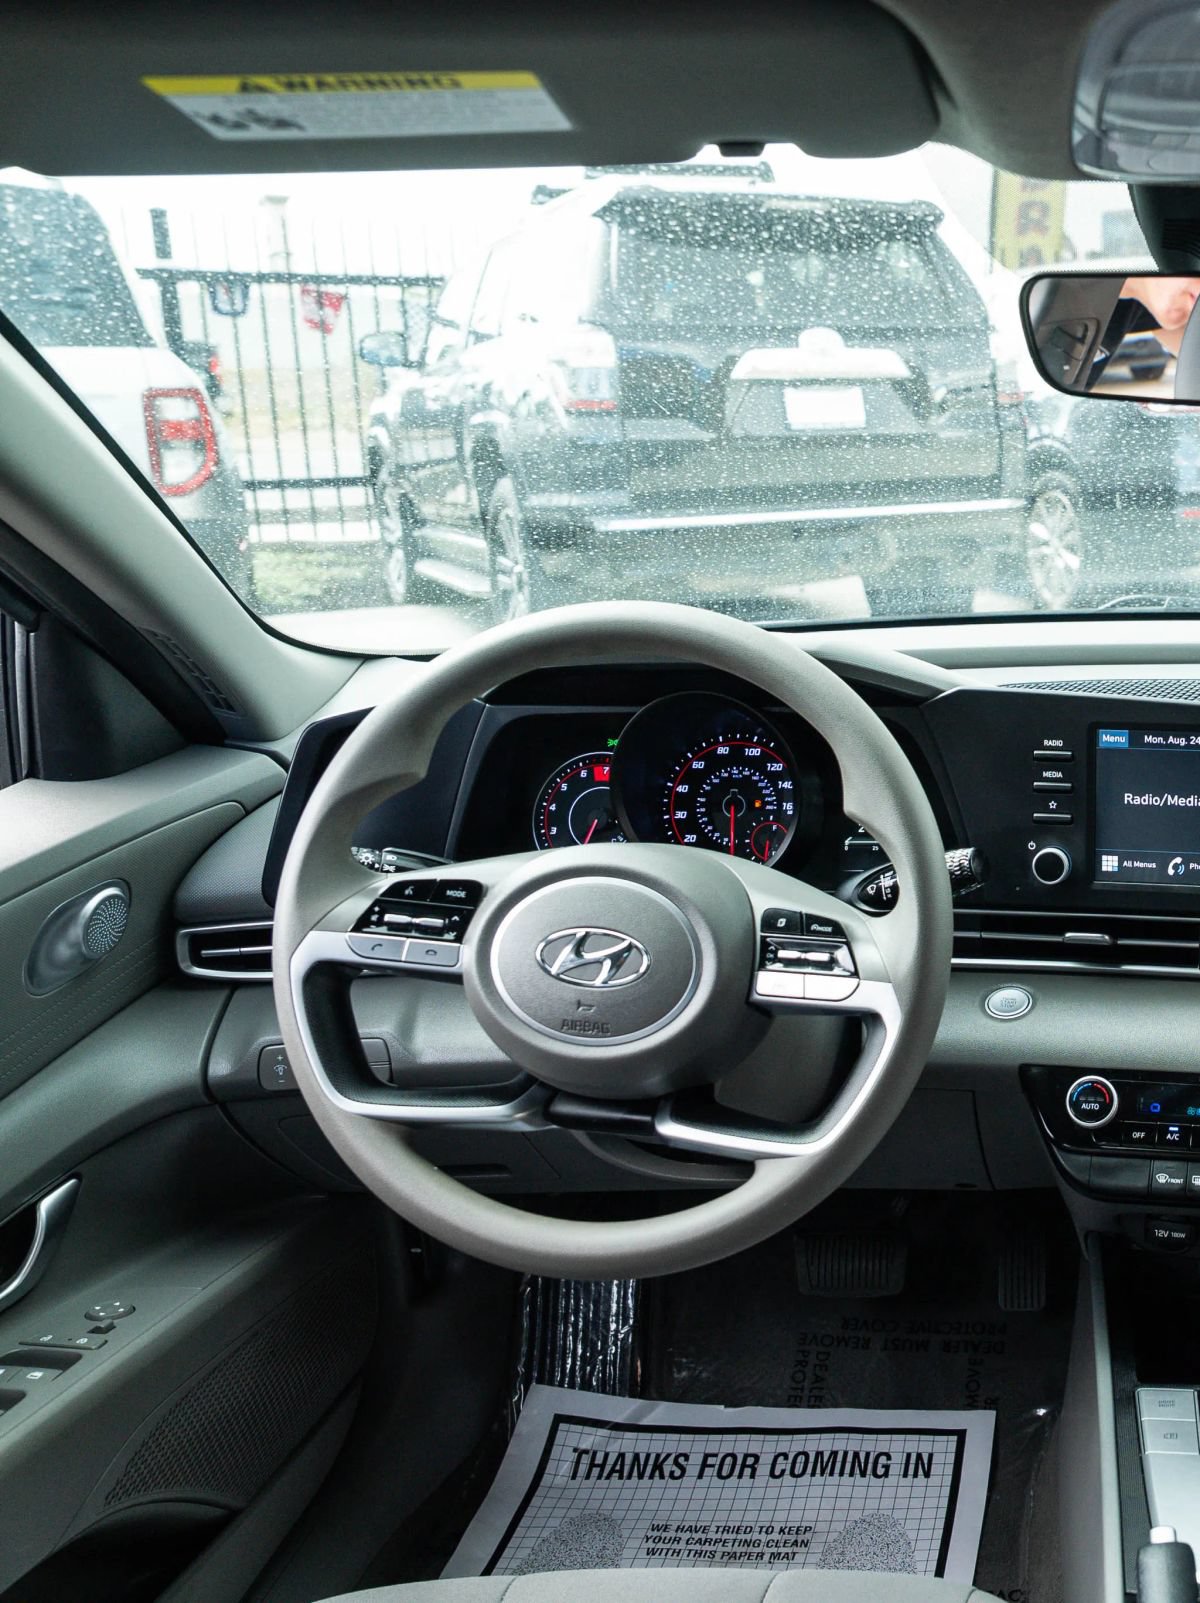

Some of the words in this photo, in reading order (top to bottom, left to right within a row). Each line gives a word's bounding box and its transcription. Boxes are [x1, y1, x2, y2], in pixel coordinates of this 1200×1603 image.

[1102, 734, 1126, 743] Menu
[1167, 736, 1188, 746] Aug.
[1043, 739, 1063, 747] RADIO
[716, 746, 730, 755] 80
[744, 748, 761, 756] 100
[692, 761, 705, 769] 60
[766, 763, 783, 771] 120
[580, 770, 588, 778] 6
[603, 766, 610, 775] 7
[1042, 771, 1063, 779] MEDIA
[561, 783, 568, 791] 5
[676, 785, 689, 793] 40
[549, 803, 556, 811] 4
[782, 802, 793, 811] 16
[674, 811, 687, 819] 30
[549, 827, 557, 835] 3
[683, 835, 697, 843] 20
[1134, 861, 1157, 869] Menus
[446, 889, 467, 898] MODE
[561, 1019, 611, 1035] AIRBAG
[1132, 1131, 1146, 1139] OFF
[1166, 1133, 1180, 1141] A/C
[1154, 1229, 1169, 1238] 12V
[798, 1332, 872, 1351] REMOVE
[570, 1448, 689, 1481] THANKS
[697, 1451, 759, 1480] FOR
[769, 1450, 891, 1479] COMING
[902, 1451, 934, 1479] IN
[651, 1523, 673, 1533] WE
[674, 1524, 711, 1534] HAVE
[714, 1525, 753, 1535] TRIED
[758, 1525, 774, 1535] TO
[778, 1525, 813, 1536] KEEP
[644, 1535, 682, 1546] YOUR
[685, 1537, 762, 1549] CARPETING
[765, 1538, 810, 1549] CLEAN
[646, 1547, 682, 1558] WITH
[686, 1549, 716, 1559] THIS
[720, 1551, 766, 1561] PAPER
[769, 1551, 799, 1562] MAT
